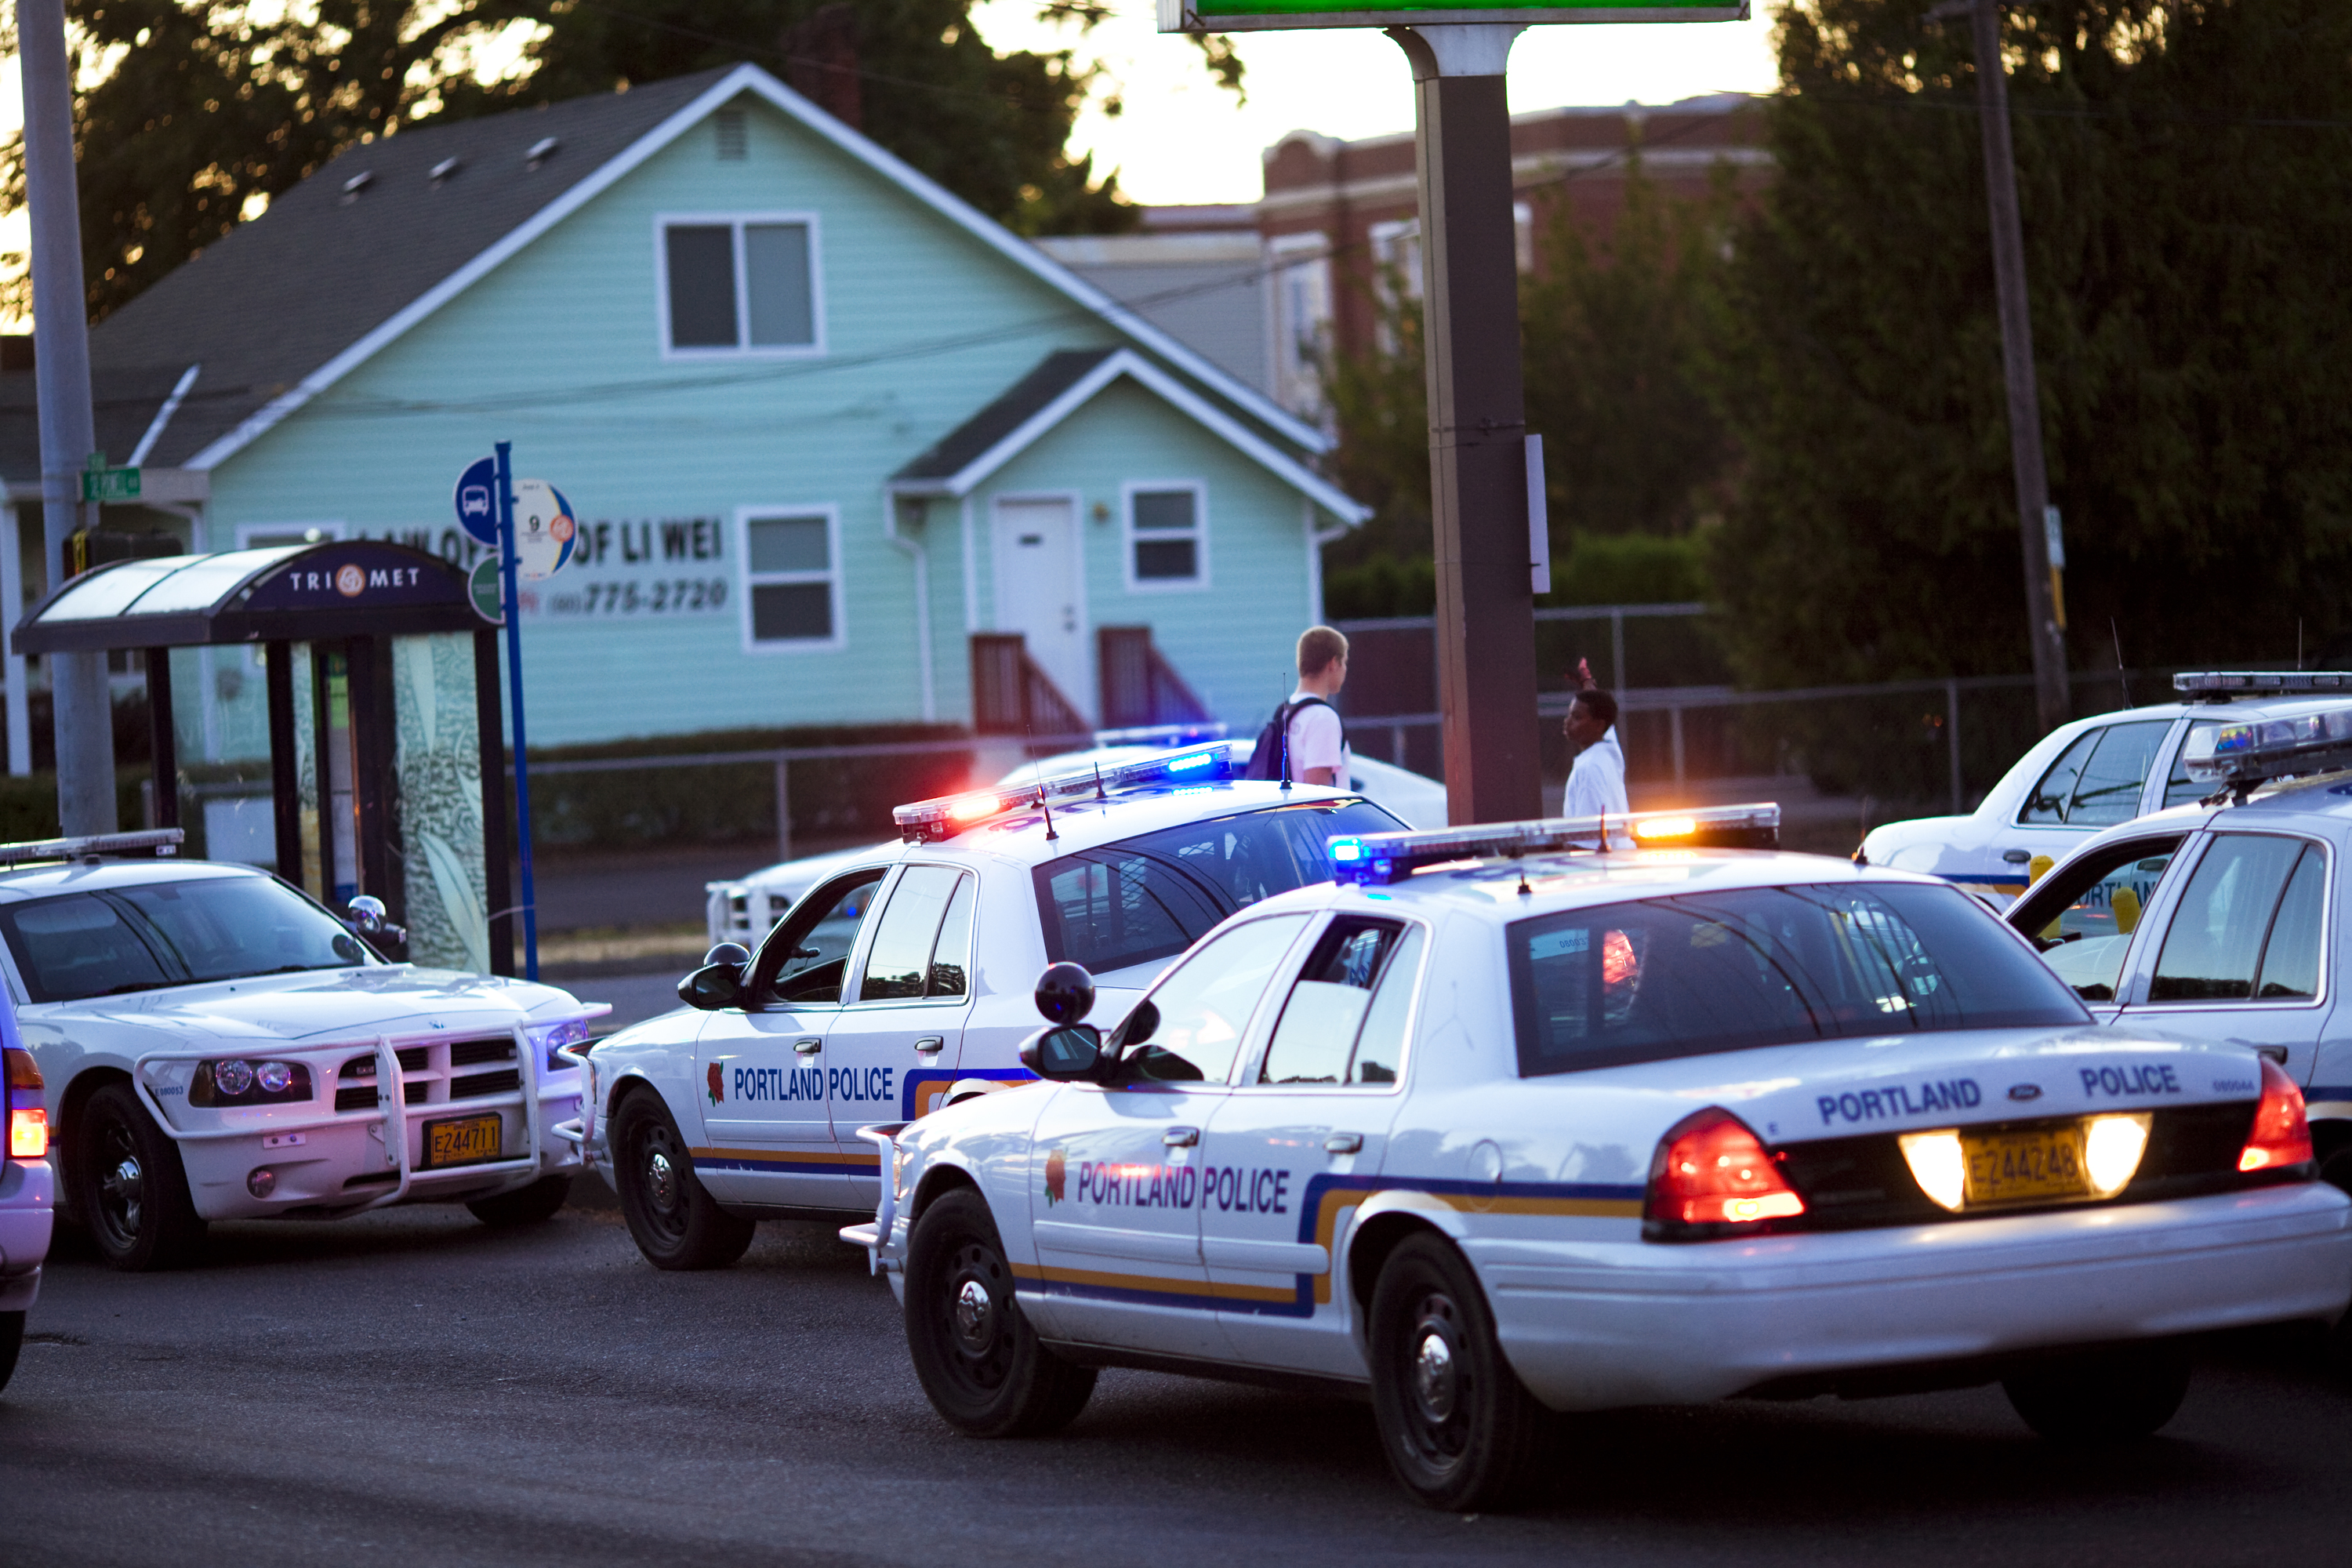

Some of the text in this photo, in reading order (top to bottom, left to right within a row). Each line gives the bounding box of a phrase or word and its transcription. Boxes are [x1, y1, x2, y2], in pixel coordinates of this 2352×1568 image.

[529, 514, 540, 532] 9
[575, 517, 721, 565] OF LI WEI
[289, 567, 419, 592] TRI MET
[735, 1067, 894, 1101] PORTLAND POLICE
[1817, 1065, 2181, 1126] PORTLAND POLICE
[434, 1126, 495, 1154] E244711
[1971, 1143, 2078, 1185] E244248
[1078, 1161, 1290, 1214] PORTLAND POLICE
